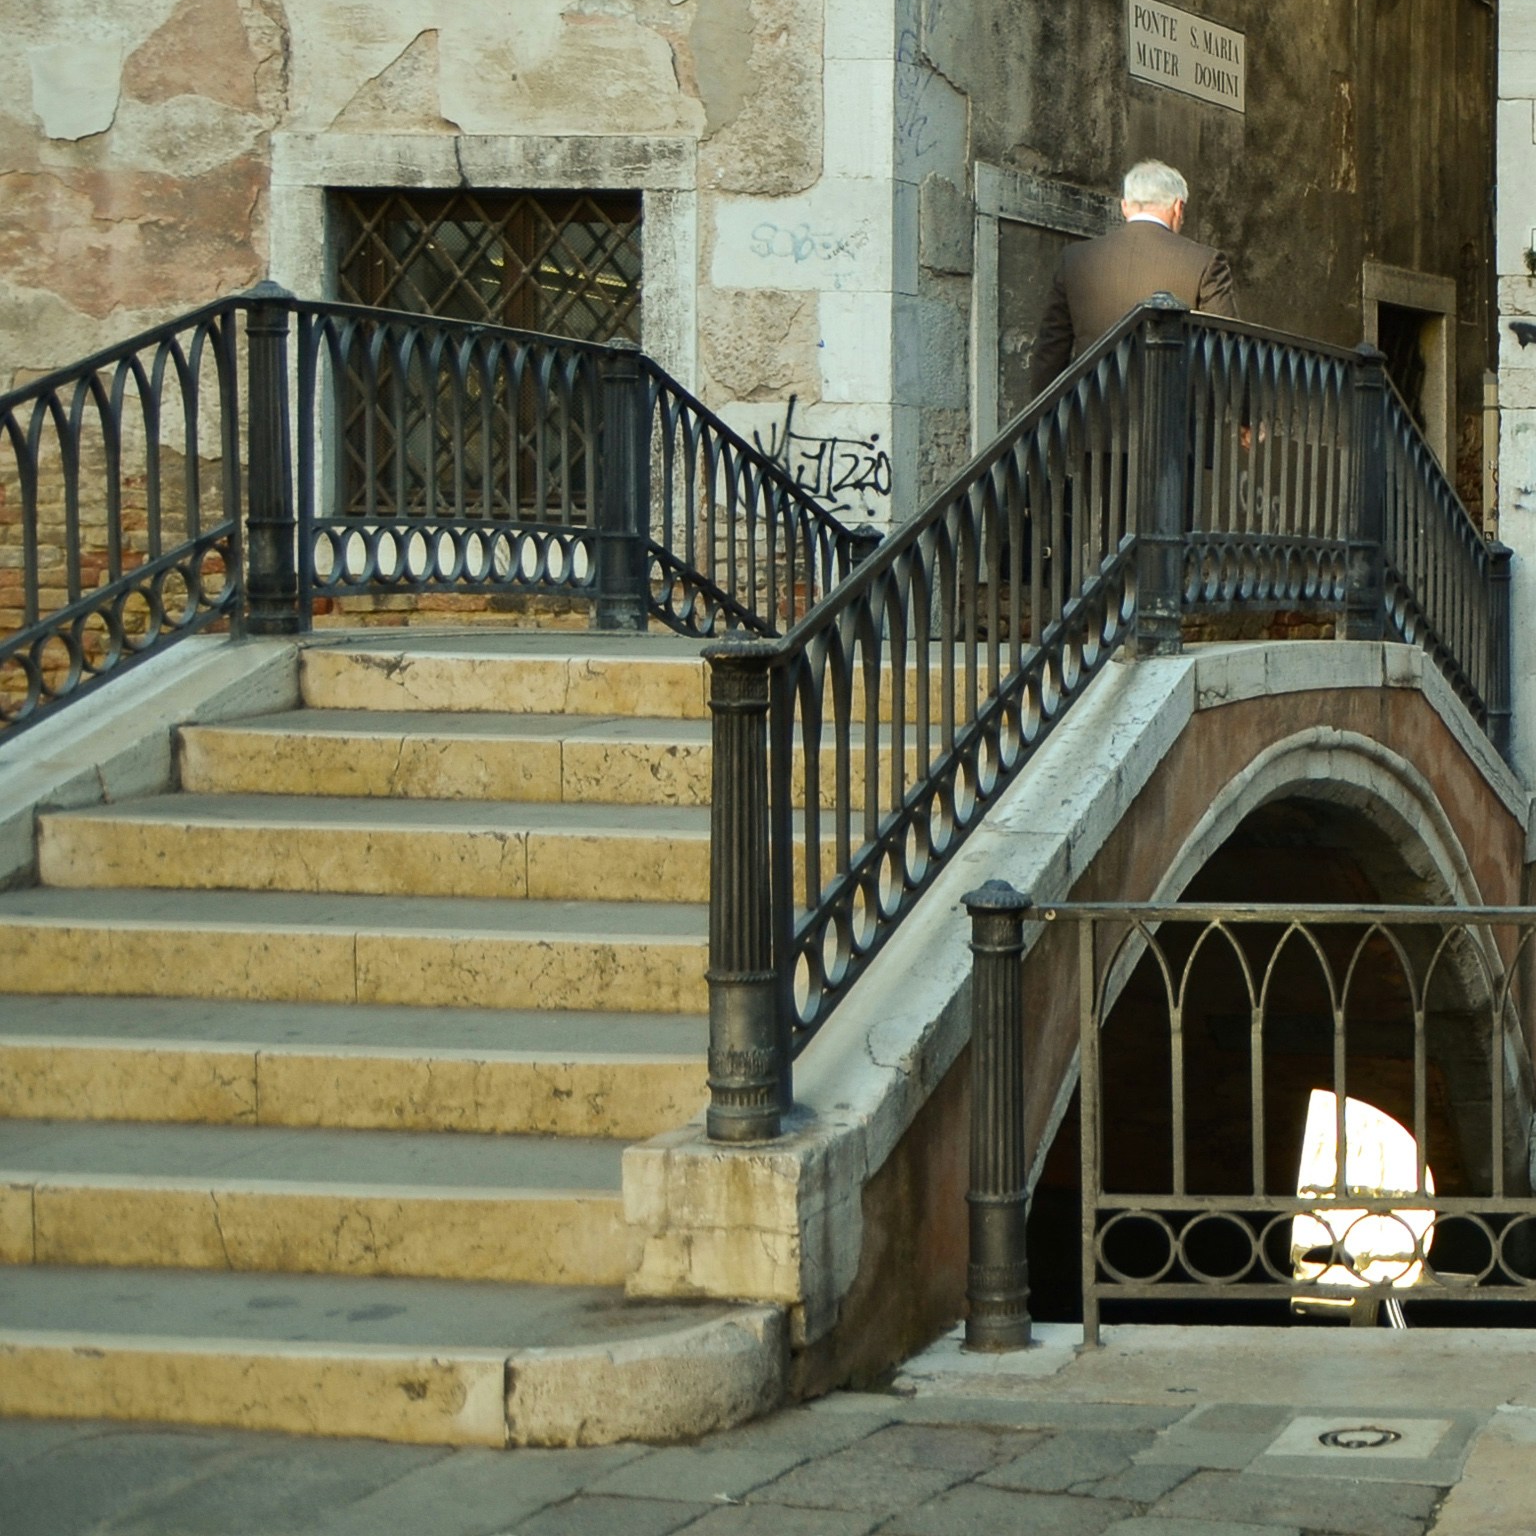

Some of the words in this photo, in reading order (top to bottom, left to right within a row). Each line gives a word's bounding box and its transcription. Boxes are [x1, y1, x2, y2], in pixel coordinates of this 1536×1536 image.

[1134, 4, 1177, 41] PONTE
[1190, 26, 1199, 49] S.
[1203, 30, 1239, 64] MARIA
[1136, 41, 1179, 77] MATER
[1195, 62, 1238, 97] DOMINI
